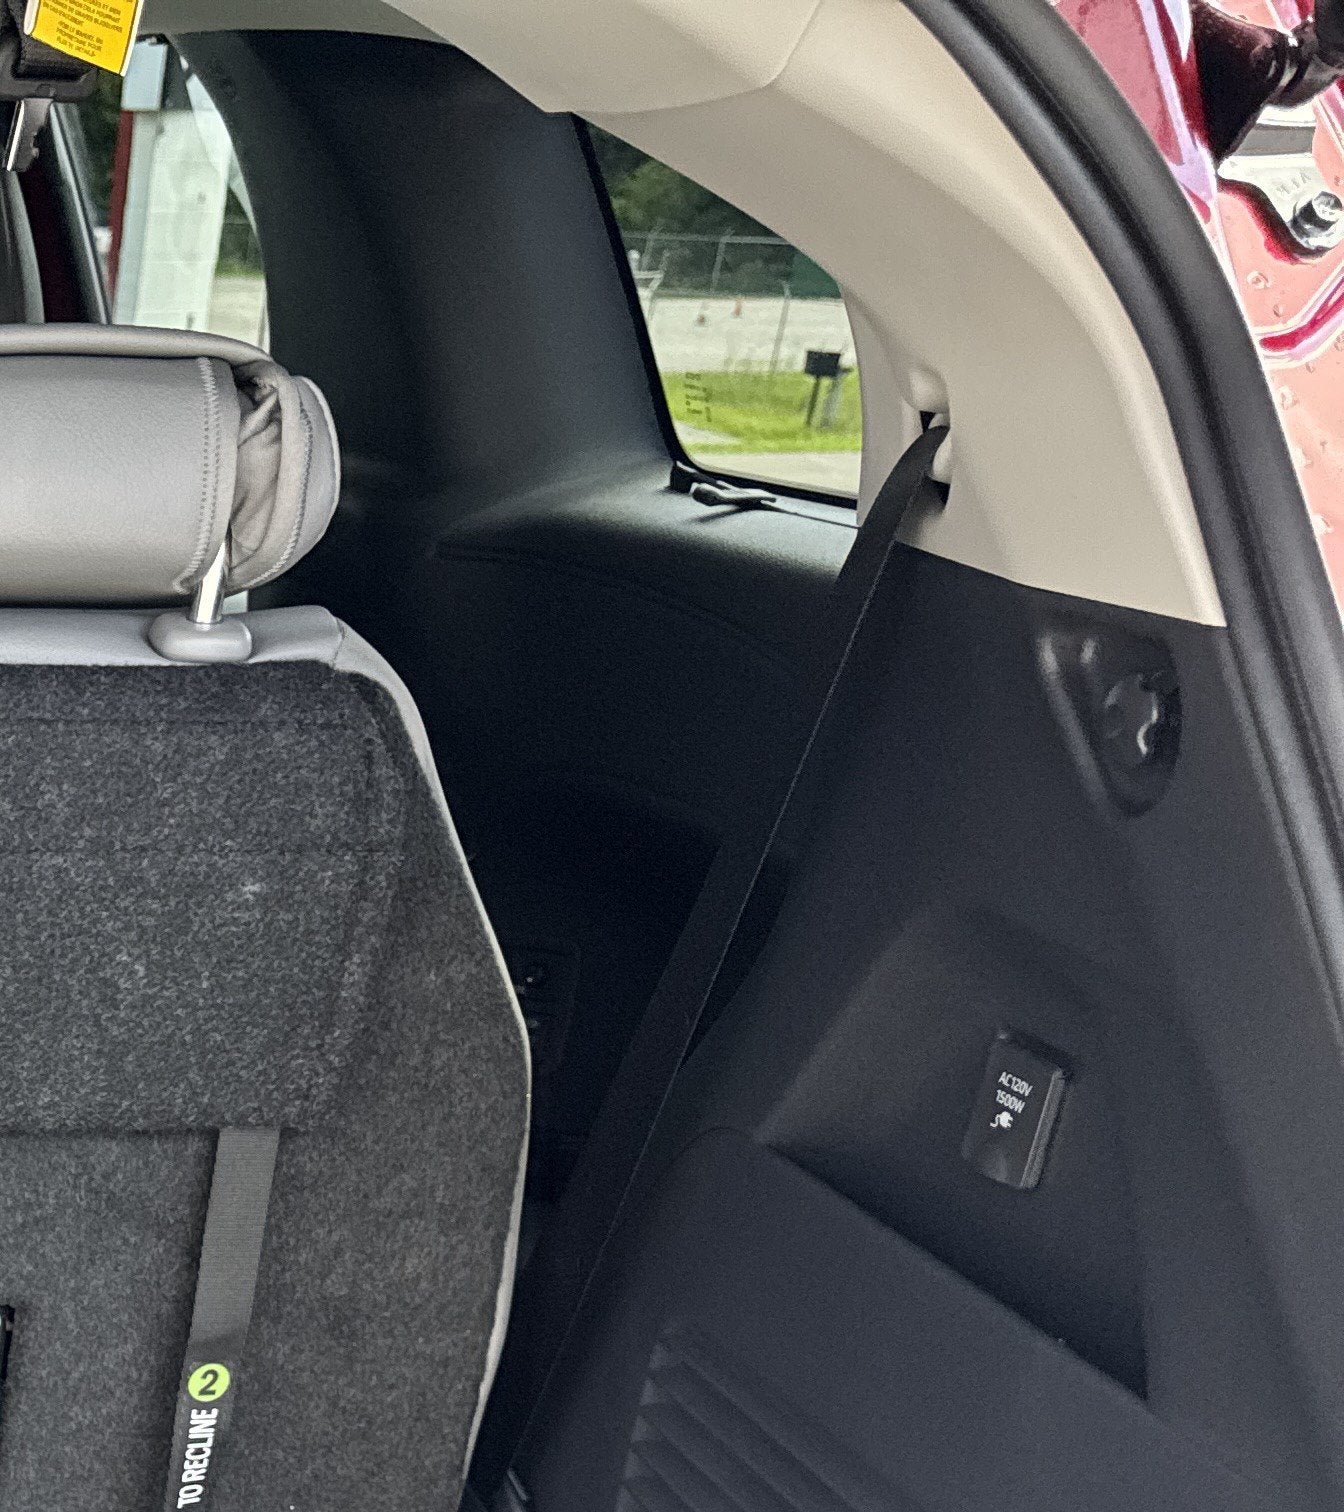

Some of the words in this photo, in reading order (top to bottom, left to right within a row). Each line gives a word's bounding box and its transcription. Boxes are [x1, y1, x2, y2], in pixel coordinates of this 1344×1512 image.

[995, 1089, 1027, 1114] 1500W
[198, 1369, 219, 1396] 2
[181, 1407, 219, 1483] RECLINE
[177, 1484, 204, 1509] TO
